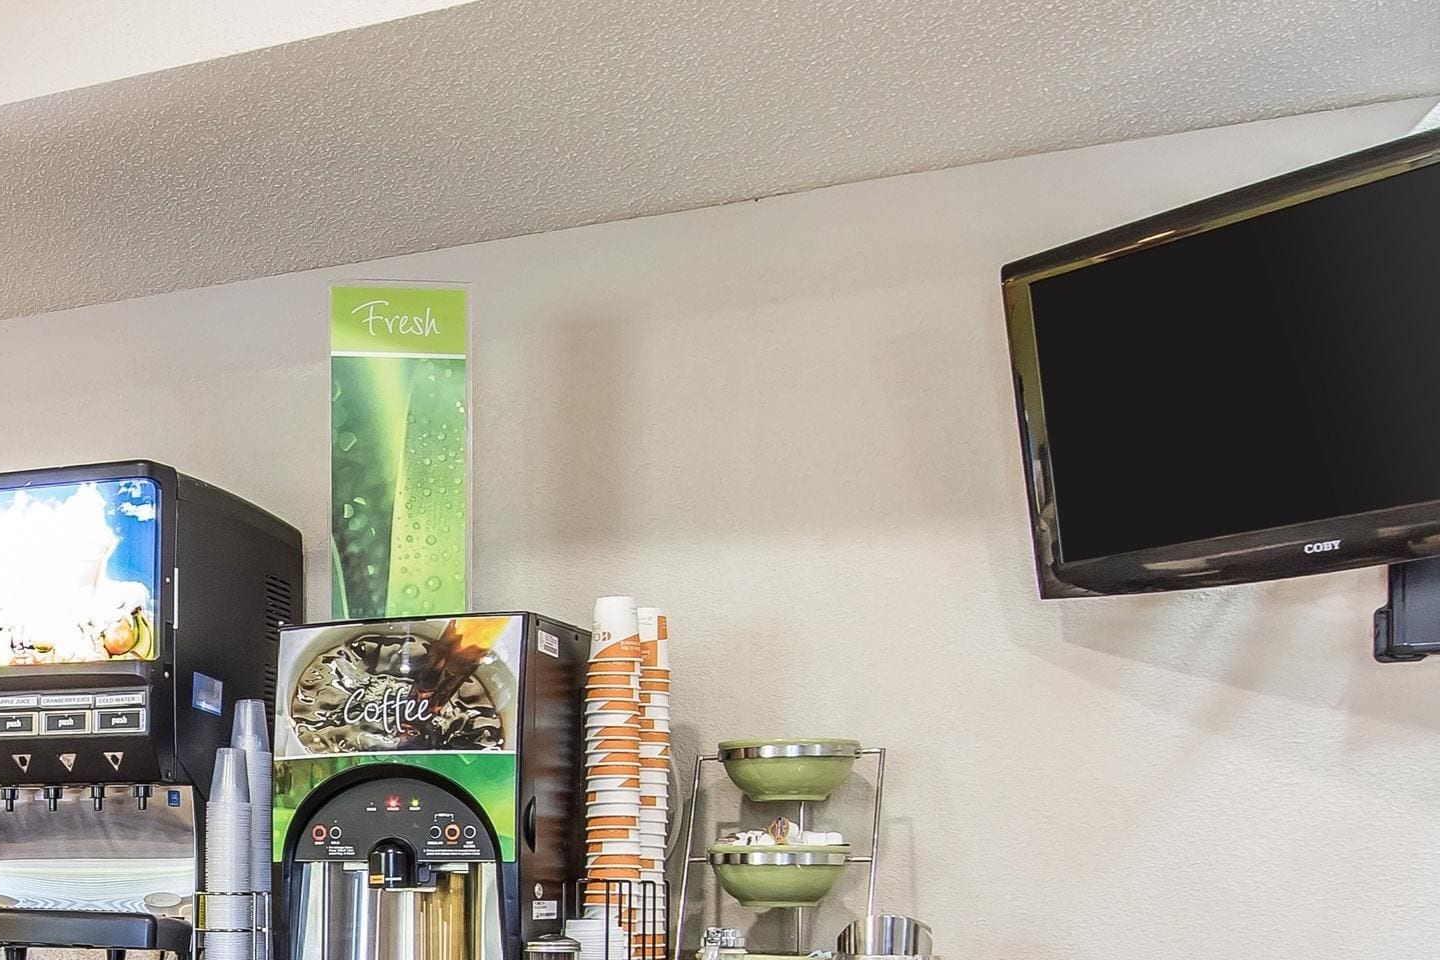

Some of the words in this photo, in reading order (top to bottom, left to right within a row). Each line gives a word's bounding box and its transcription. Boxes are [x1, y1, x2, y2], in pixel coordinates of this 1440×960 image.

[352, 300, 440, 336] Fresh
[1304, 540, 1341, 554] COBY
[343, 687, 432, 734] Coffee
[6, 719, 21, 729] push
[58, 717, 74, 728] push
[111, 715, 128, 725] push
